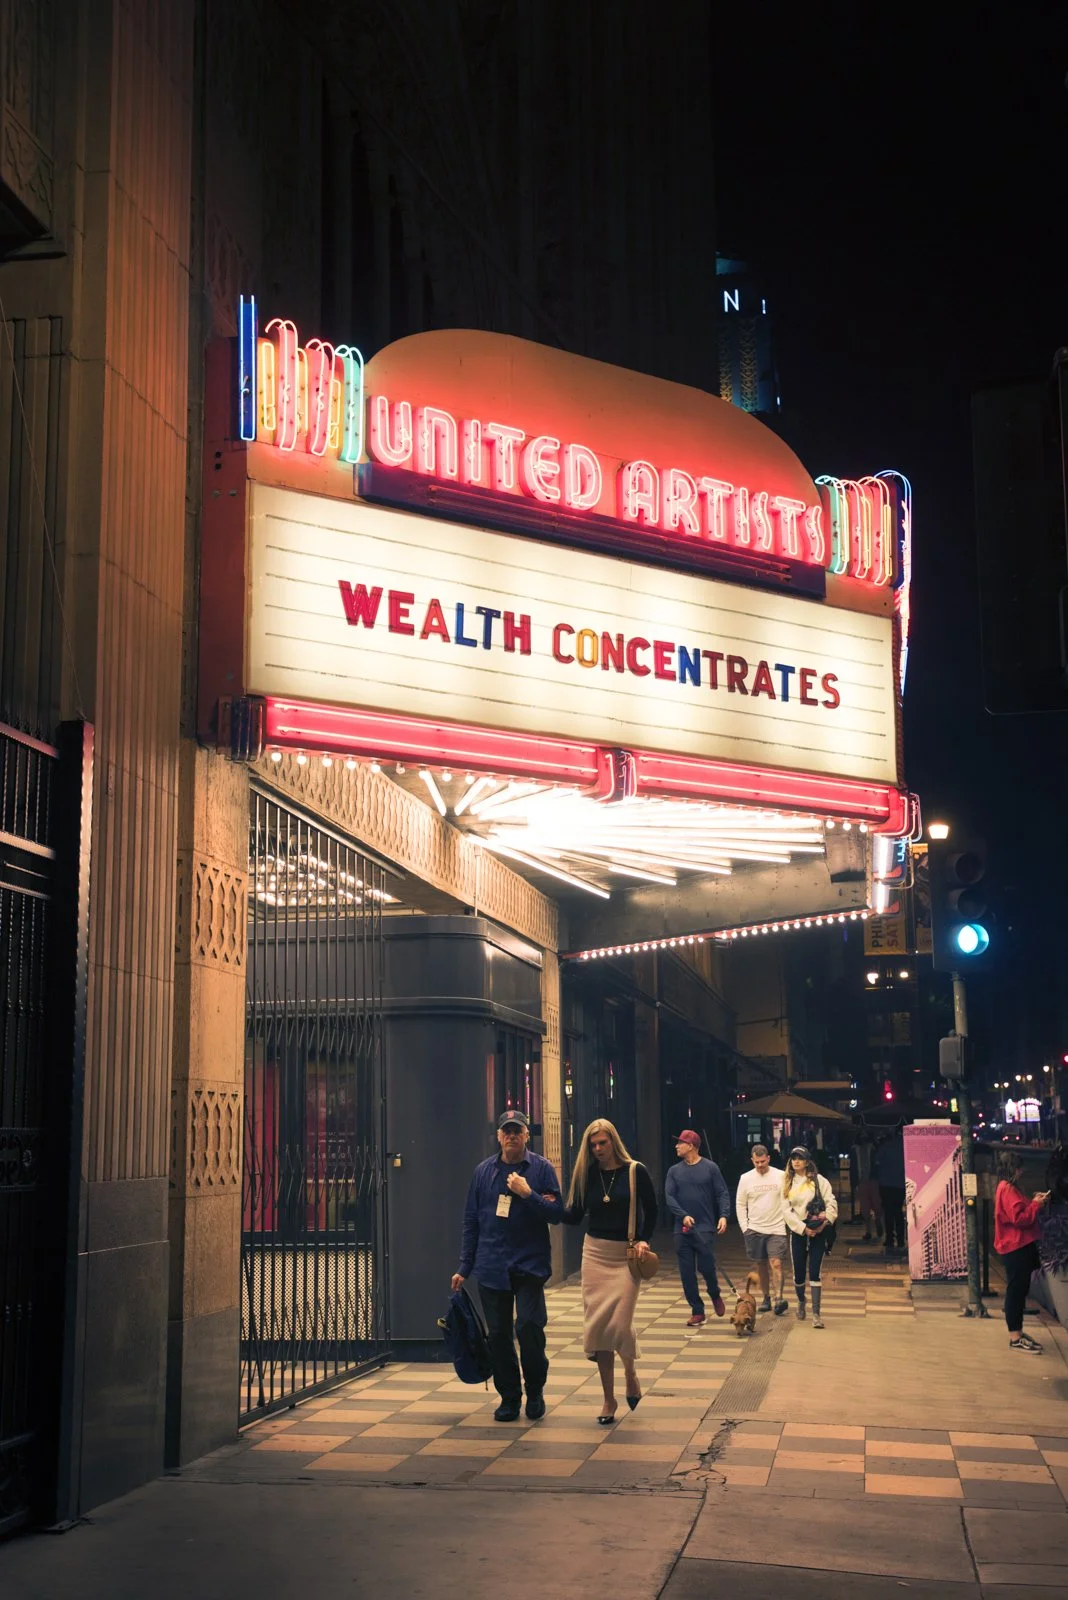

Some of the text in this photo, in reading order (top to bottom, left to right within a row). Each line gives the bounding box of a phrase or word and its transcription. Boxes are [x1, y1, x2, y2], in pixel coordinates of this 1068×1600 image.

[368, 394, 826, 564] UNITED ARTISTS
[338, 578, 841, 711] WEALTH CONCENTRATES
